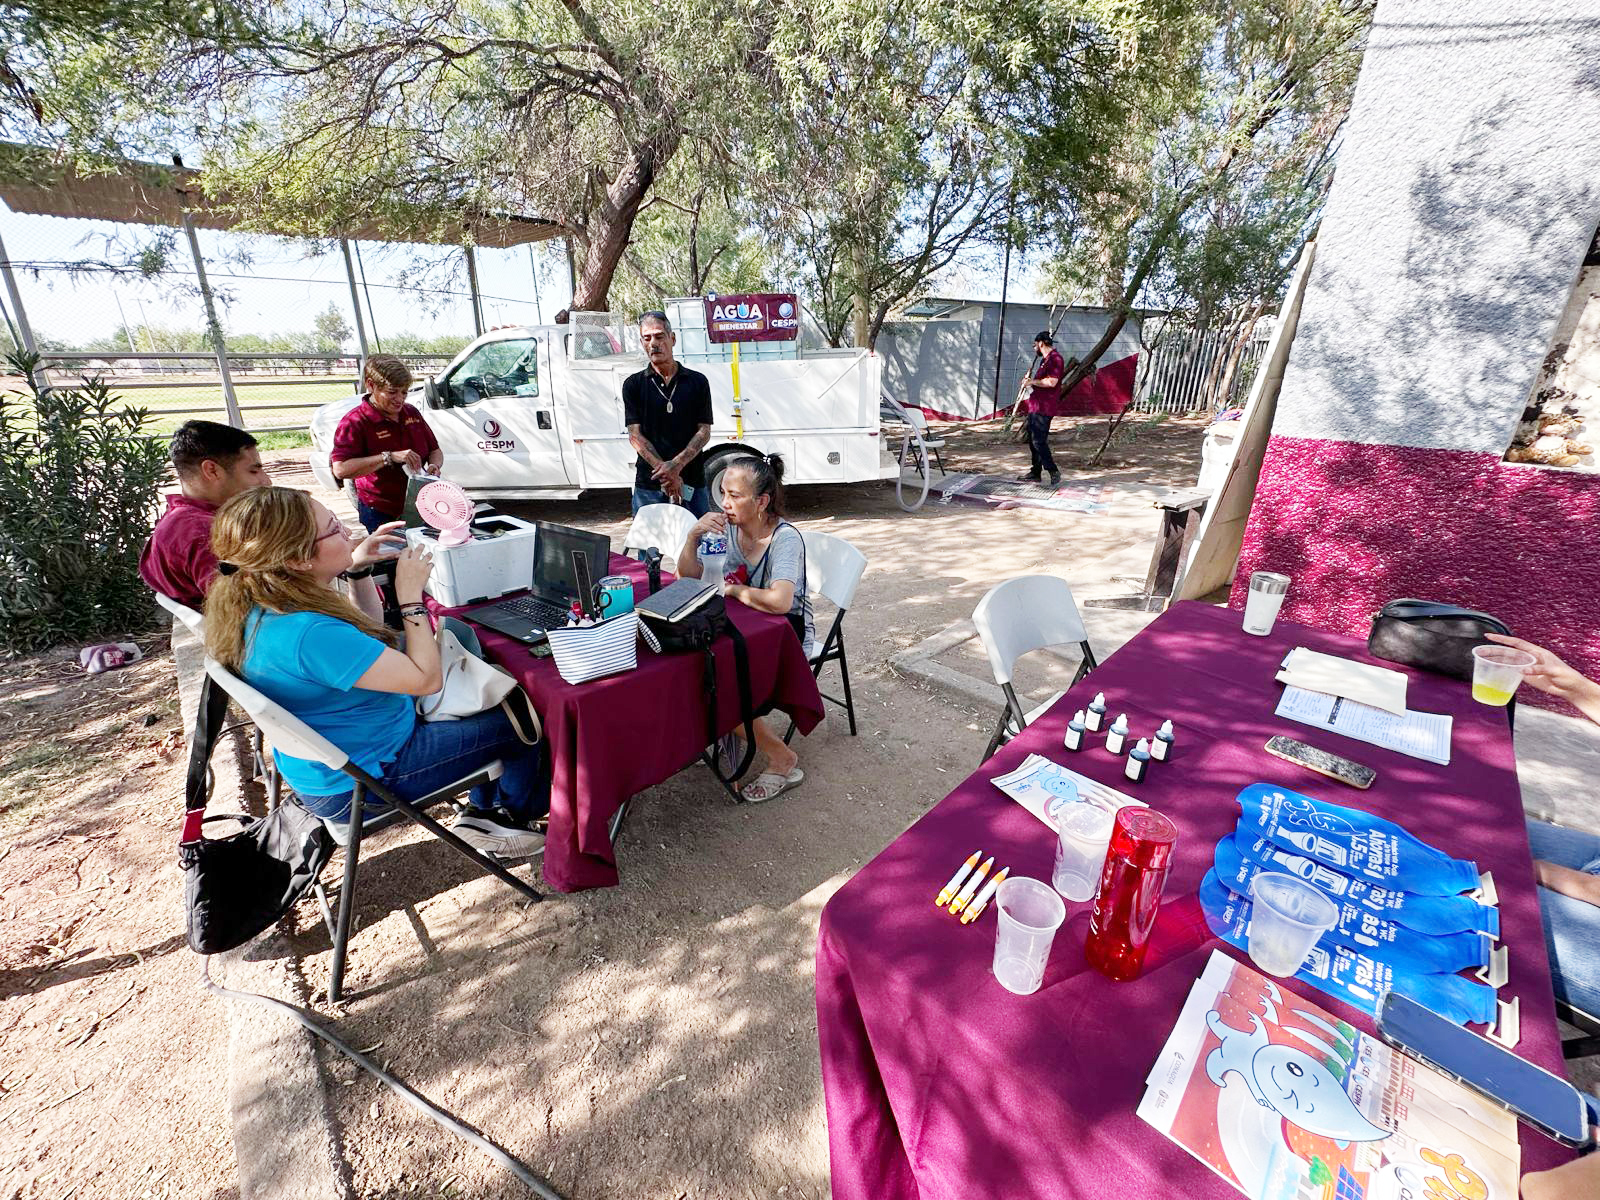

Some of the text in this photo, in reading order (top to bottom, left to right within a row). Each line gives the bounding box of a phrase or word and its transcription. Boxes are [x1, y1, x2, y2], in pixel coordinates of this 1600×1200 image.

[712, 302, 763, 319] AGUA
[719, 323, 758, 331] BIENESTAR
[477, 440, 515, 450] CESPM
[1367, 828, 1387, 872] Ahorras
